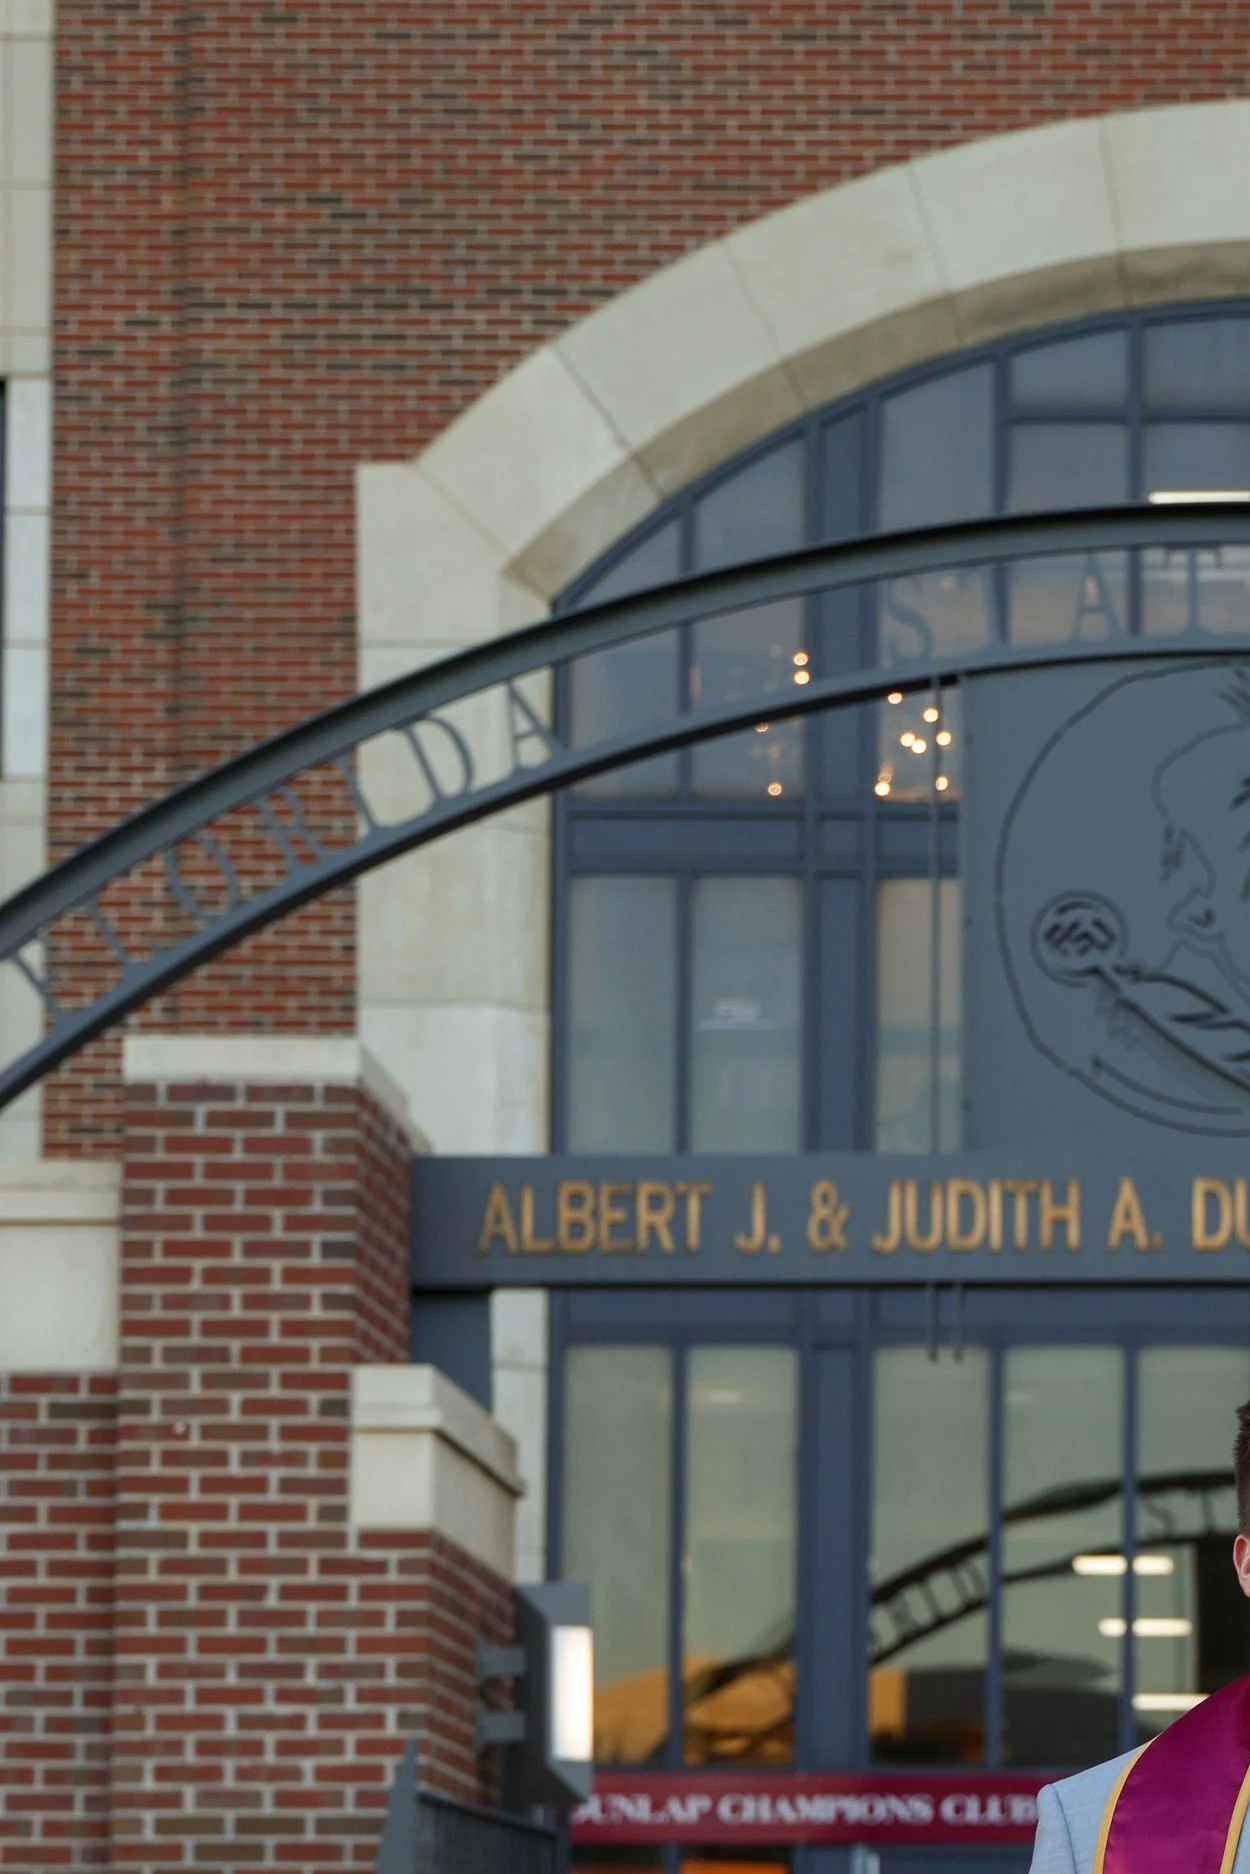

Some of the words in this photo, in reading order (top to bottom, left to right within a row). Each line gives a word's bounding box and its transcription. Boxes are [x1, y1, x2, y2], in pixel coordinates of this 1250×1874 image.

[478, 1181, 712, 1254] ALBERT
[735, 1182, 781, 1254] J.
[806, 1180, 849, 1253] &
[871, 1178, 1081, 1253] JUDITH
[1107, 1178, 1163, 1252] A.
[717, 1794, 935, 1826] CHAMPIONS
